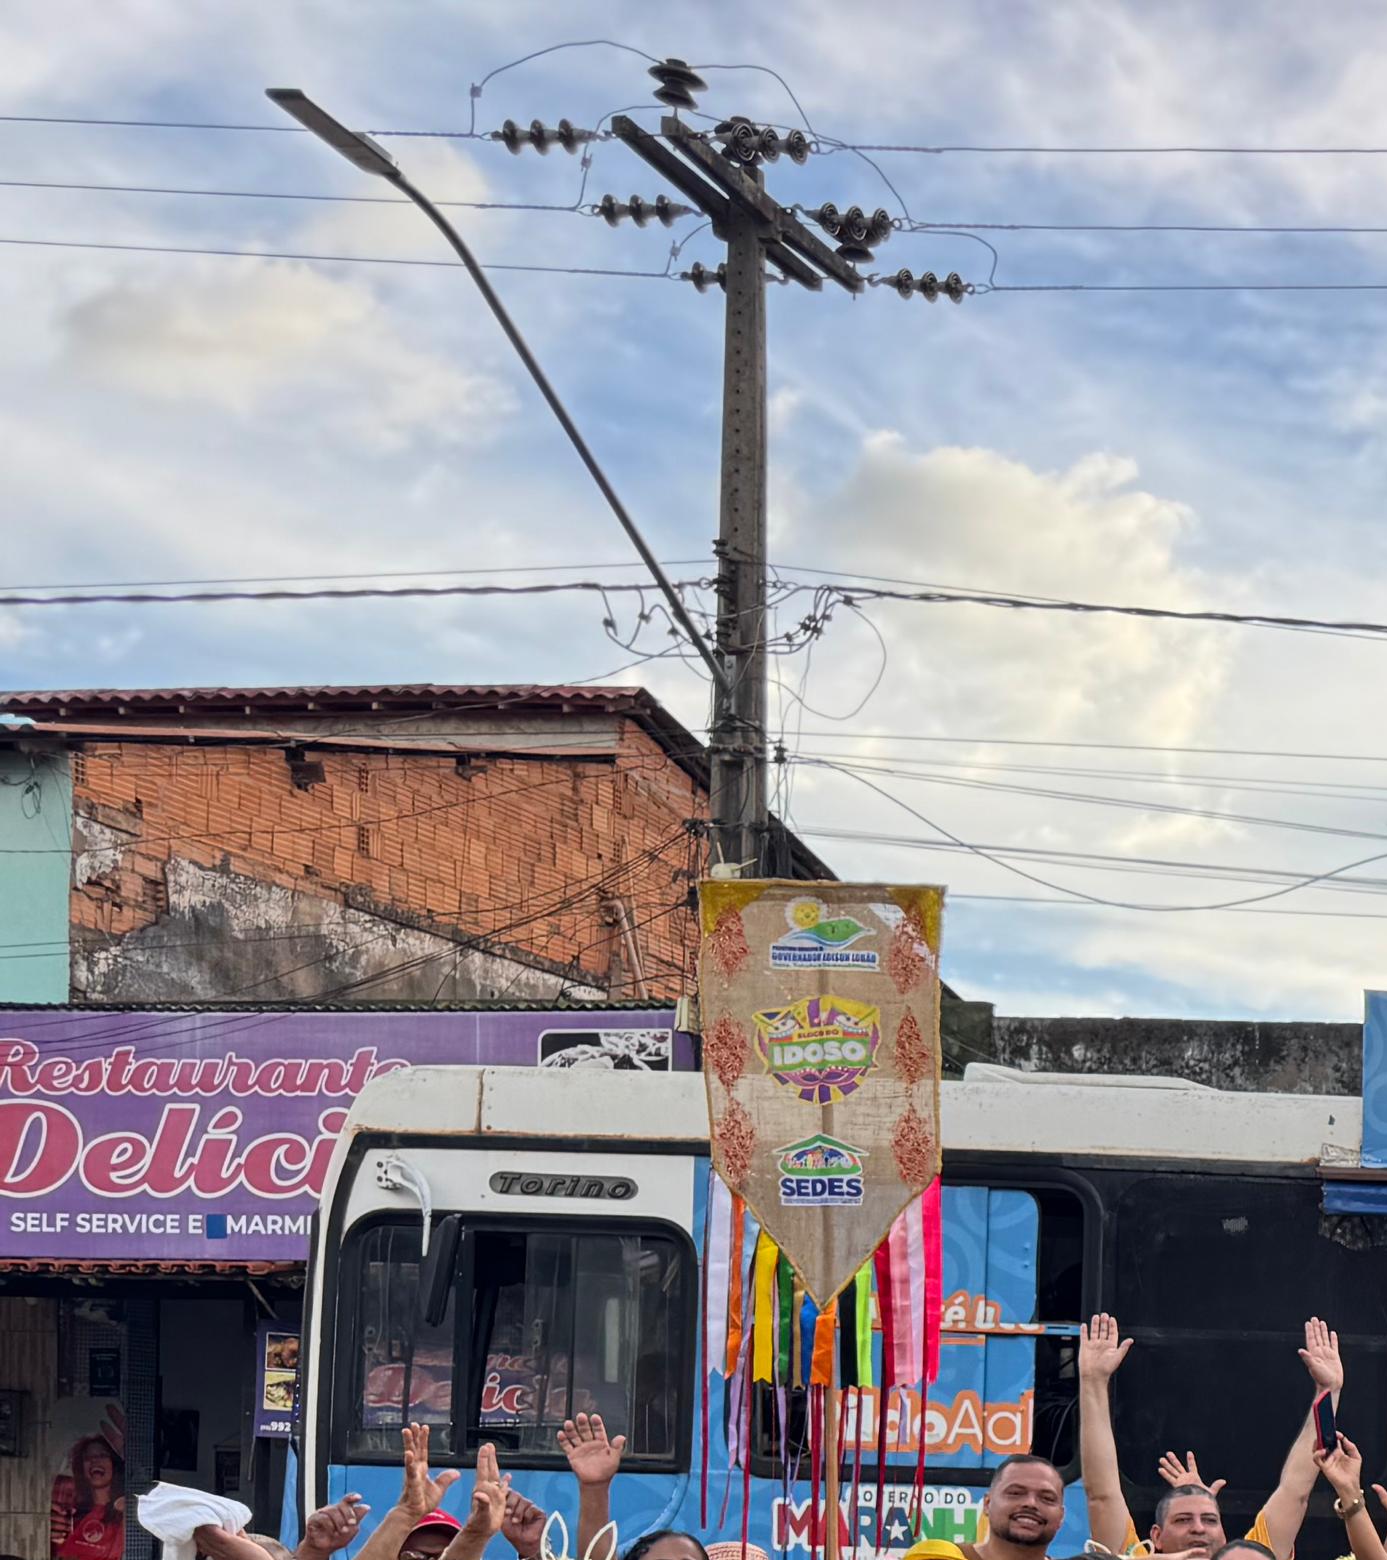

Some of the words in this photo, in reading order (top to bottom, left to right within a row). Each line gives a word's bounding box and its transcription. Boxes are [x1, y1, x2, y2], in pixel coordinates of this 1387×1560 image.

[773, 1040, 867, 1066] IDOSO
[499, 1173, 632, 1199] Torino
[781, 1177, 863, 1198] SEDES
[10, 1213, 70, 1234] SELF
[76, 1213, 180, 1234] SERVICE
[188, 1214, 203, 1234] E
[944, 1492, 966, 1505] DO
